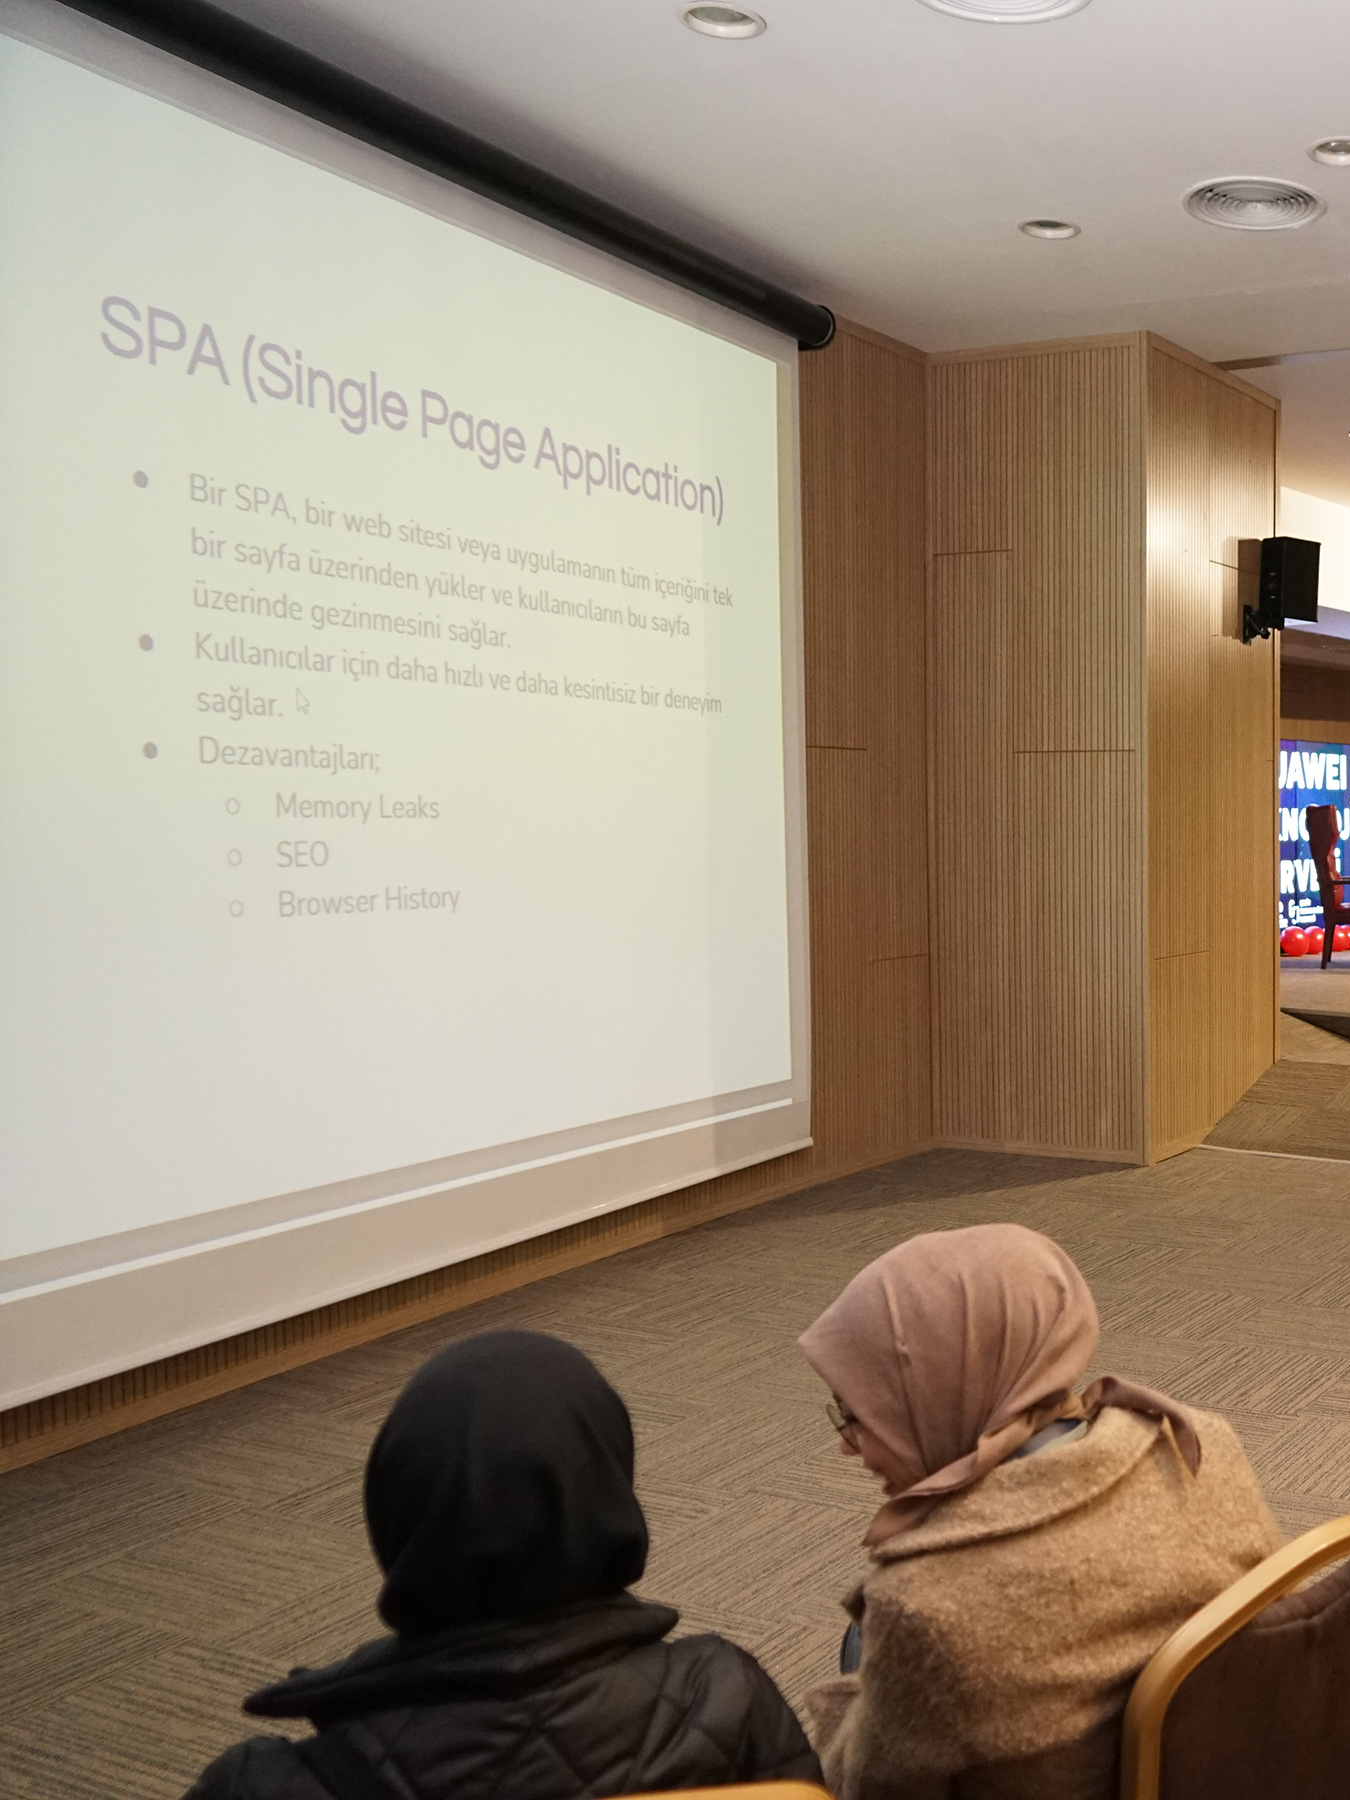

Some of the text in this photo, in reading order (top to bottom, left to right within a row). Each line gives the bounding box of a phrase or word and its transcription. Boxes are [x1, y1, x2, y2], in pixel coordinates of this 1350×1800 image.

[99, 294, 725, 527] SPA (Single Page Application)
[188, 471, 734, 608] Bir SPA, bir web sitesi veya uygulamanın tüm içeriğini tek
[190, 526, 691, 639] bir sayfa üzerinden yükler ve kullanıcıların bu sayfa
[192, 579, 512, 651] üzerinde gezinmesini sağlar.
[194, 630, 723, 716] Kullanıcılar için daha hızlı ve daha kesintisiz bir deneyim
[195, 684, 284, 723] sağlar.
[197, 735, 381, 776] Dezavantajları;
[275, 791, 441, 826] Memory Leaks
[276, 839, 330, 869] SEO
[278, 885, 461, 919] Browser History
